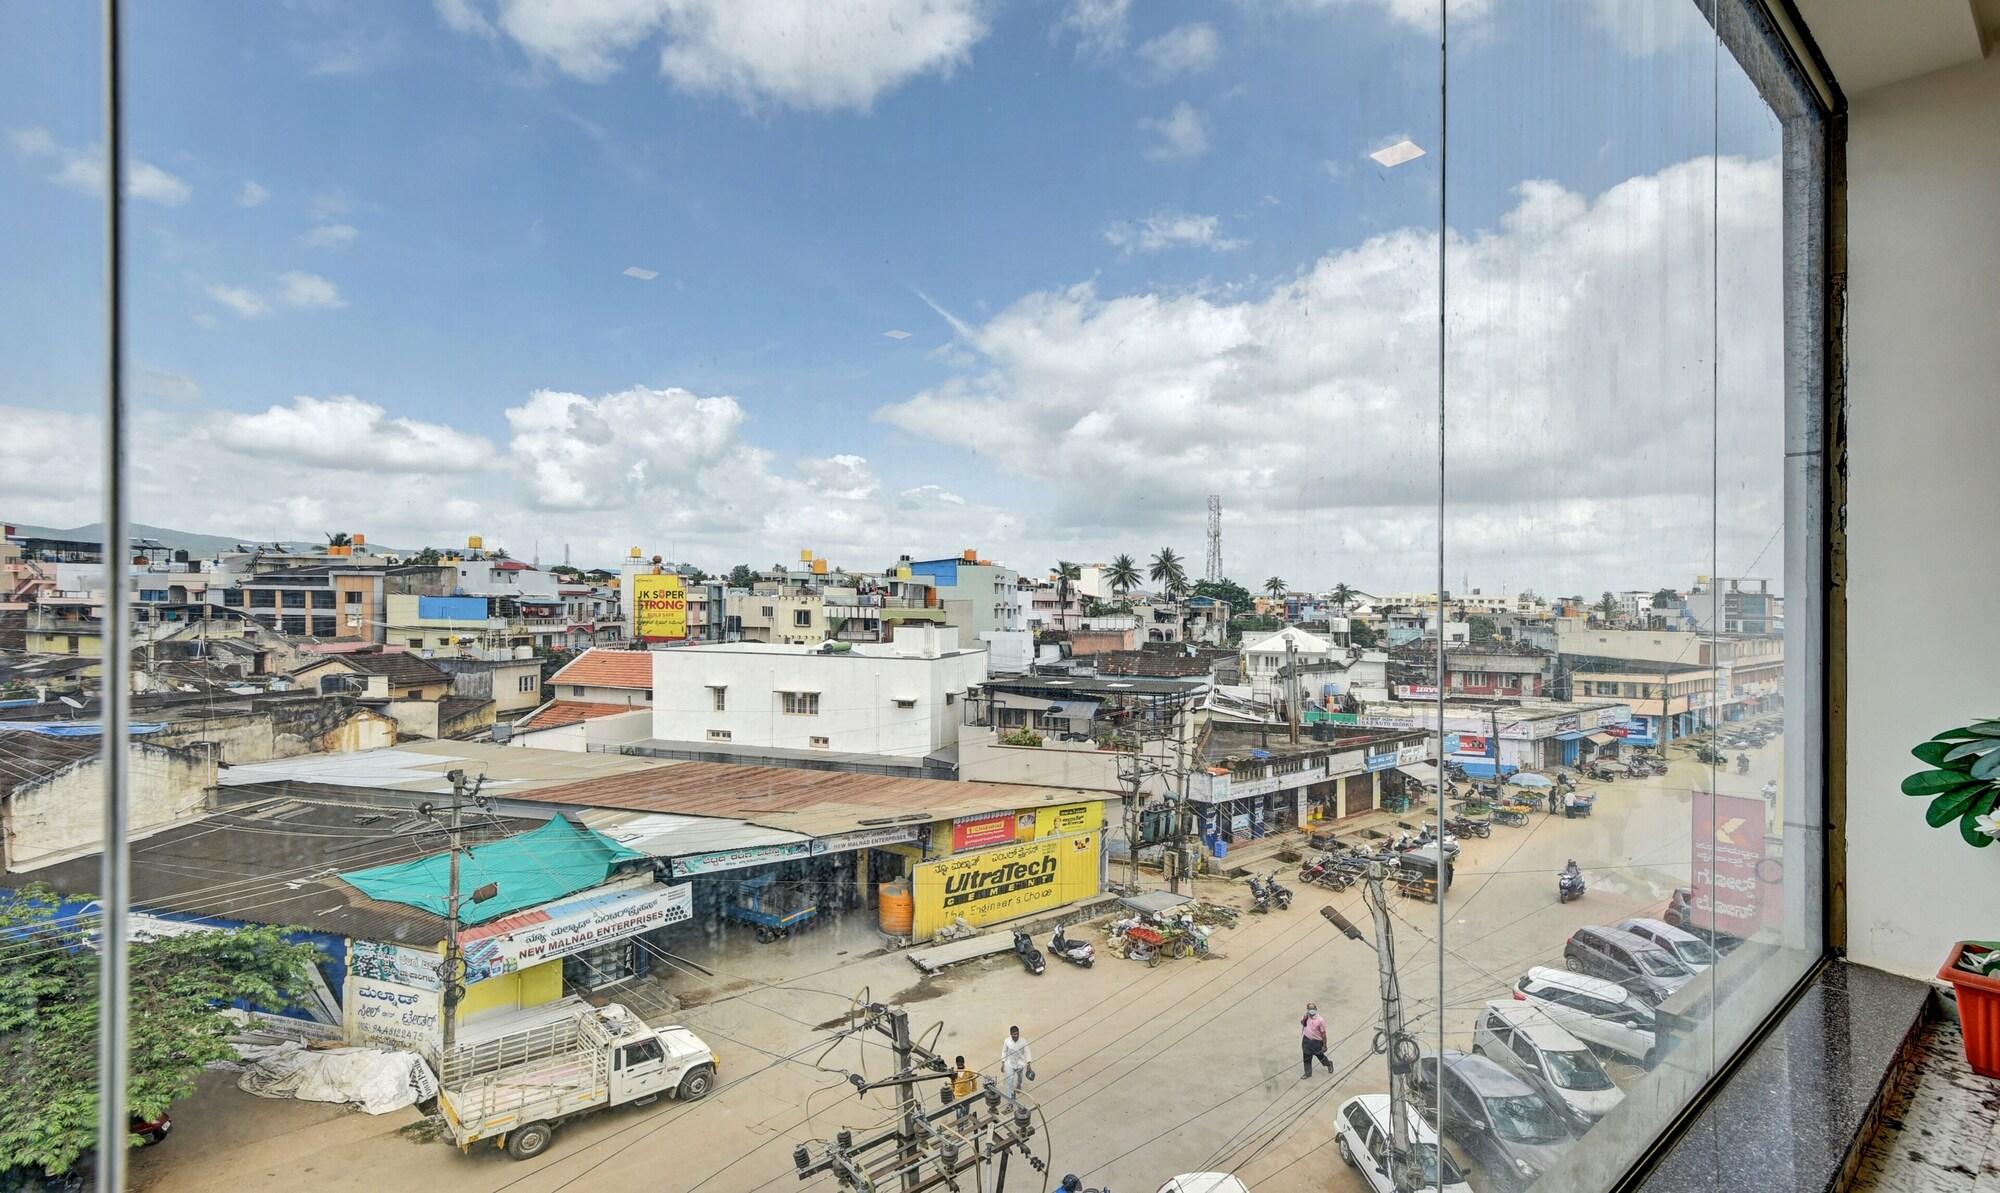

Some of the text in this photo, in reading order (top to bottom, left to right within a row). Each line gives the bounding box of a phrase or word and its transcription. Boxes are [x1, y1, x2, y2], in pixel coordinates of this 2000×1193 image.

[638, 589, 684, 599] JK SUPER
[639, 600, 684, 610] STRONG
[848, 839, 870, 847] MALNAD
[872, 834, 906, 844] ENTERPRISES
[945, 855, 1057, 895] UltraTech
[945, 874, 1051, 907] CEMENT
[519, 945, 545, 960] NEW
[548, 931, 593, 951] MALNAD
[596, 910, 664, 936] ENTERPRISES
